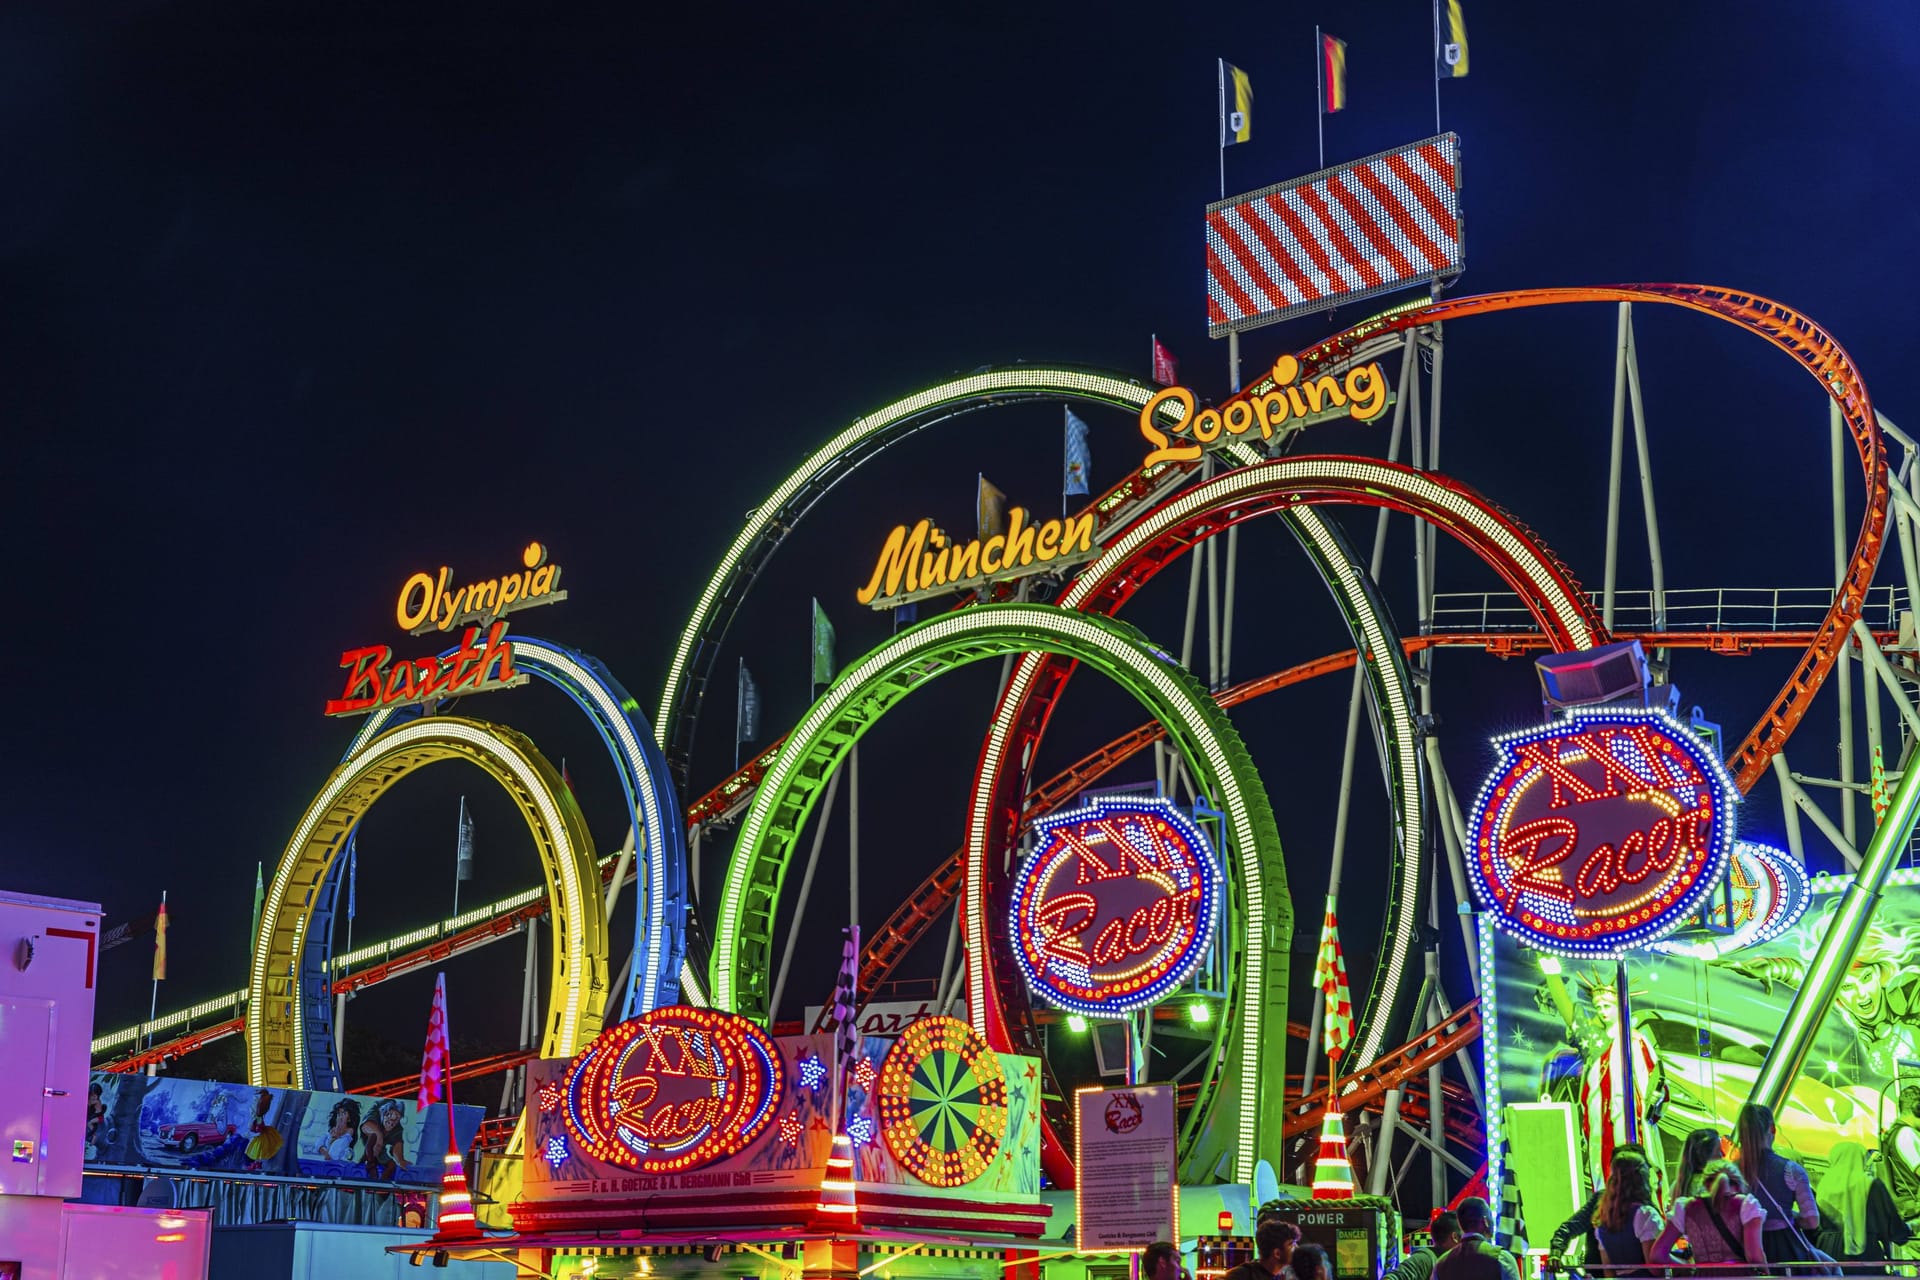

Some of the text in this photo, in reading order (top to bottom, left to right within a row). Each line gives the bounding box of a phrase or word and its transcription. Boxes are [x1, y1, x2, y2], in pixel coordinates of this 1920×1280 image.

[1140, 355, 1389, 468] Looping
[397, 542, 561, 630] Olympia
[857, 507, 1096, 604] München
[325, 621, 518, 715] Barth
[1501, 811, 1706, 915] Racer
[1035, 889, 1195, 978] Racer
[609, 1075, 724, 1141] Racer
[1105, 1110, 1143, 1131] Racer
[592, 1181, 599, 1193] F.
[611, 1180, 620, 1192] H.
[622, 1177, 658, 1192] GOETZKE
[660, 1176, 666, 1190] &
[668, 1176, 678, 1190] A.
[680, 1173, 730, 1189] BERGMANN
[1297, 1213, 1345, 1225] POWER
[1339, 1230, 1366, 1239] DANGER
